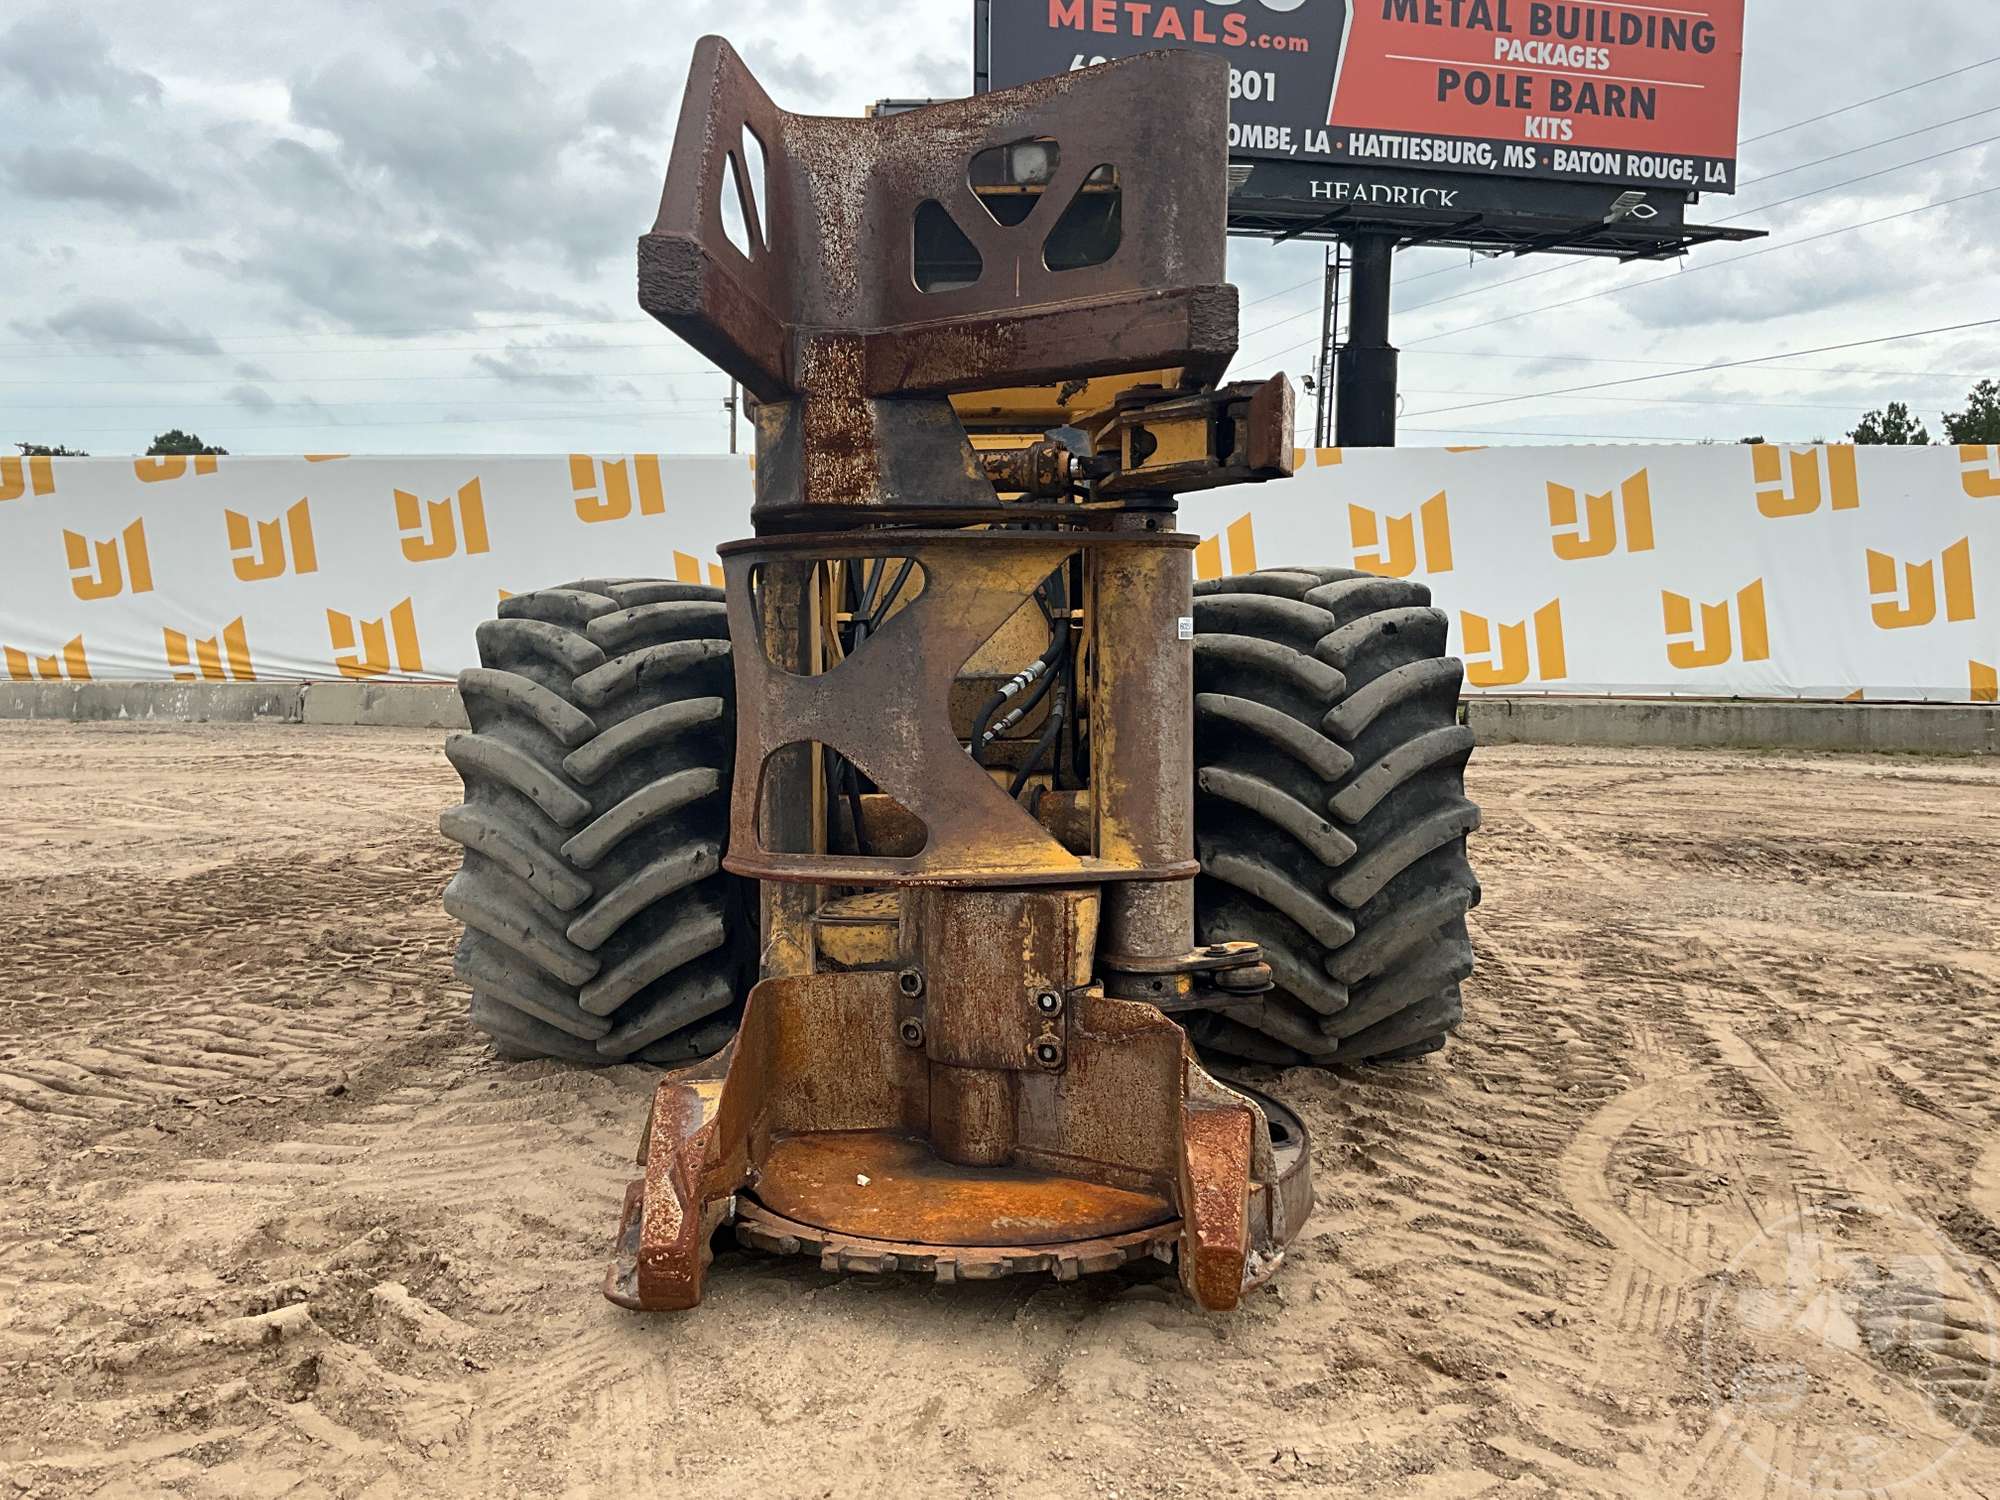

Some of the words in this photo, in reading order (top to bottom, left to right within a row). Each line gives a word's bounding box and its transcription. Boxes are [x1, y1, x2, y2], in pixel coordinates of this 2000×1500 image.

[1381, 0, 1512, 33] METAL
[1529, 3, 1716, 54] BUILDING
[1494, 37, 1610, 70] PACKAGES
[1438, 68, 1533, 110] POLE
[1550, 78, 1656, 121] BARN
[1524, 115, 1574, 142] KITS
[1304, 128, 1331, 154] LA
[1348, 132, 1498, 170] HATTIESBURG,
[1503, 144, 1537, 169] MS
[1553, 149, 1621, 175] BATON
[1626, 155, 1699, 185] ROUGE,
[1704, 161, 1727, 184] LA
[1309, 180, 1460, 207] HEADRICK
